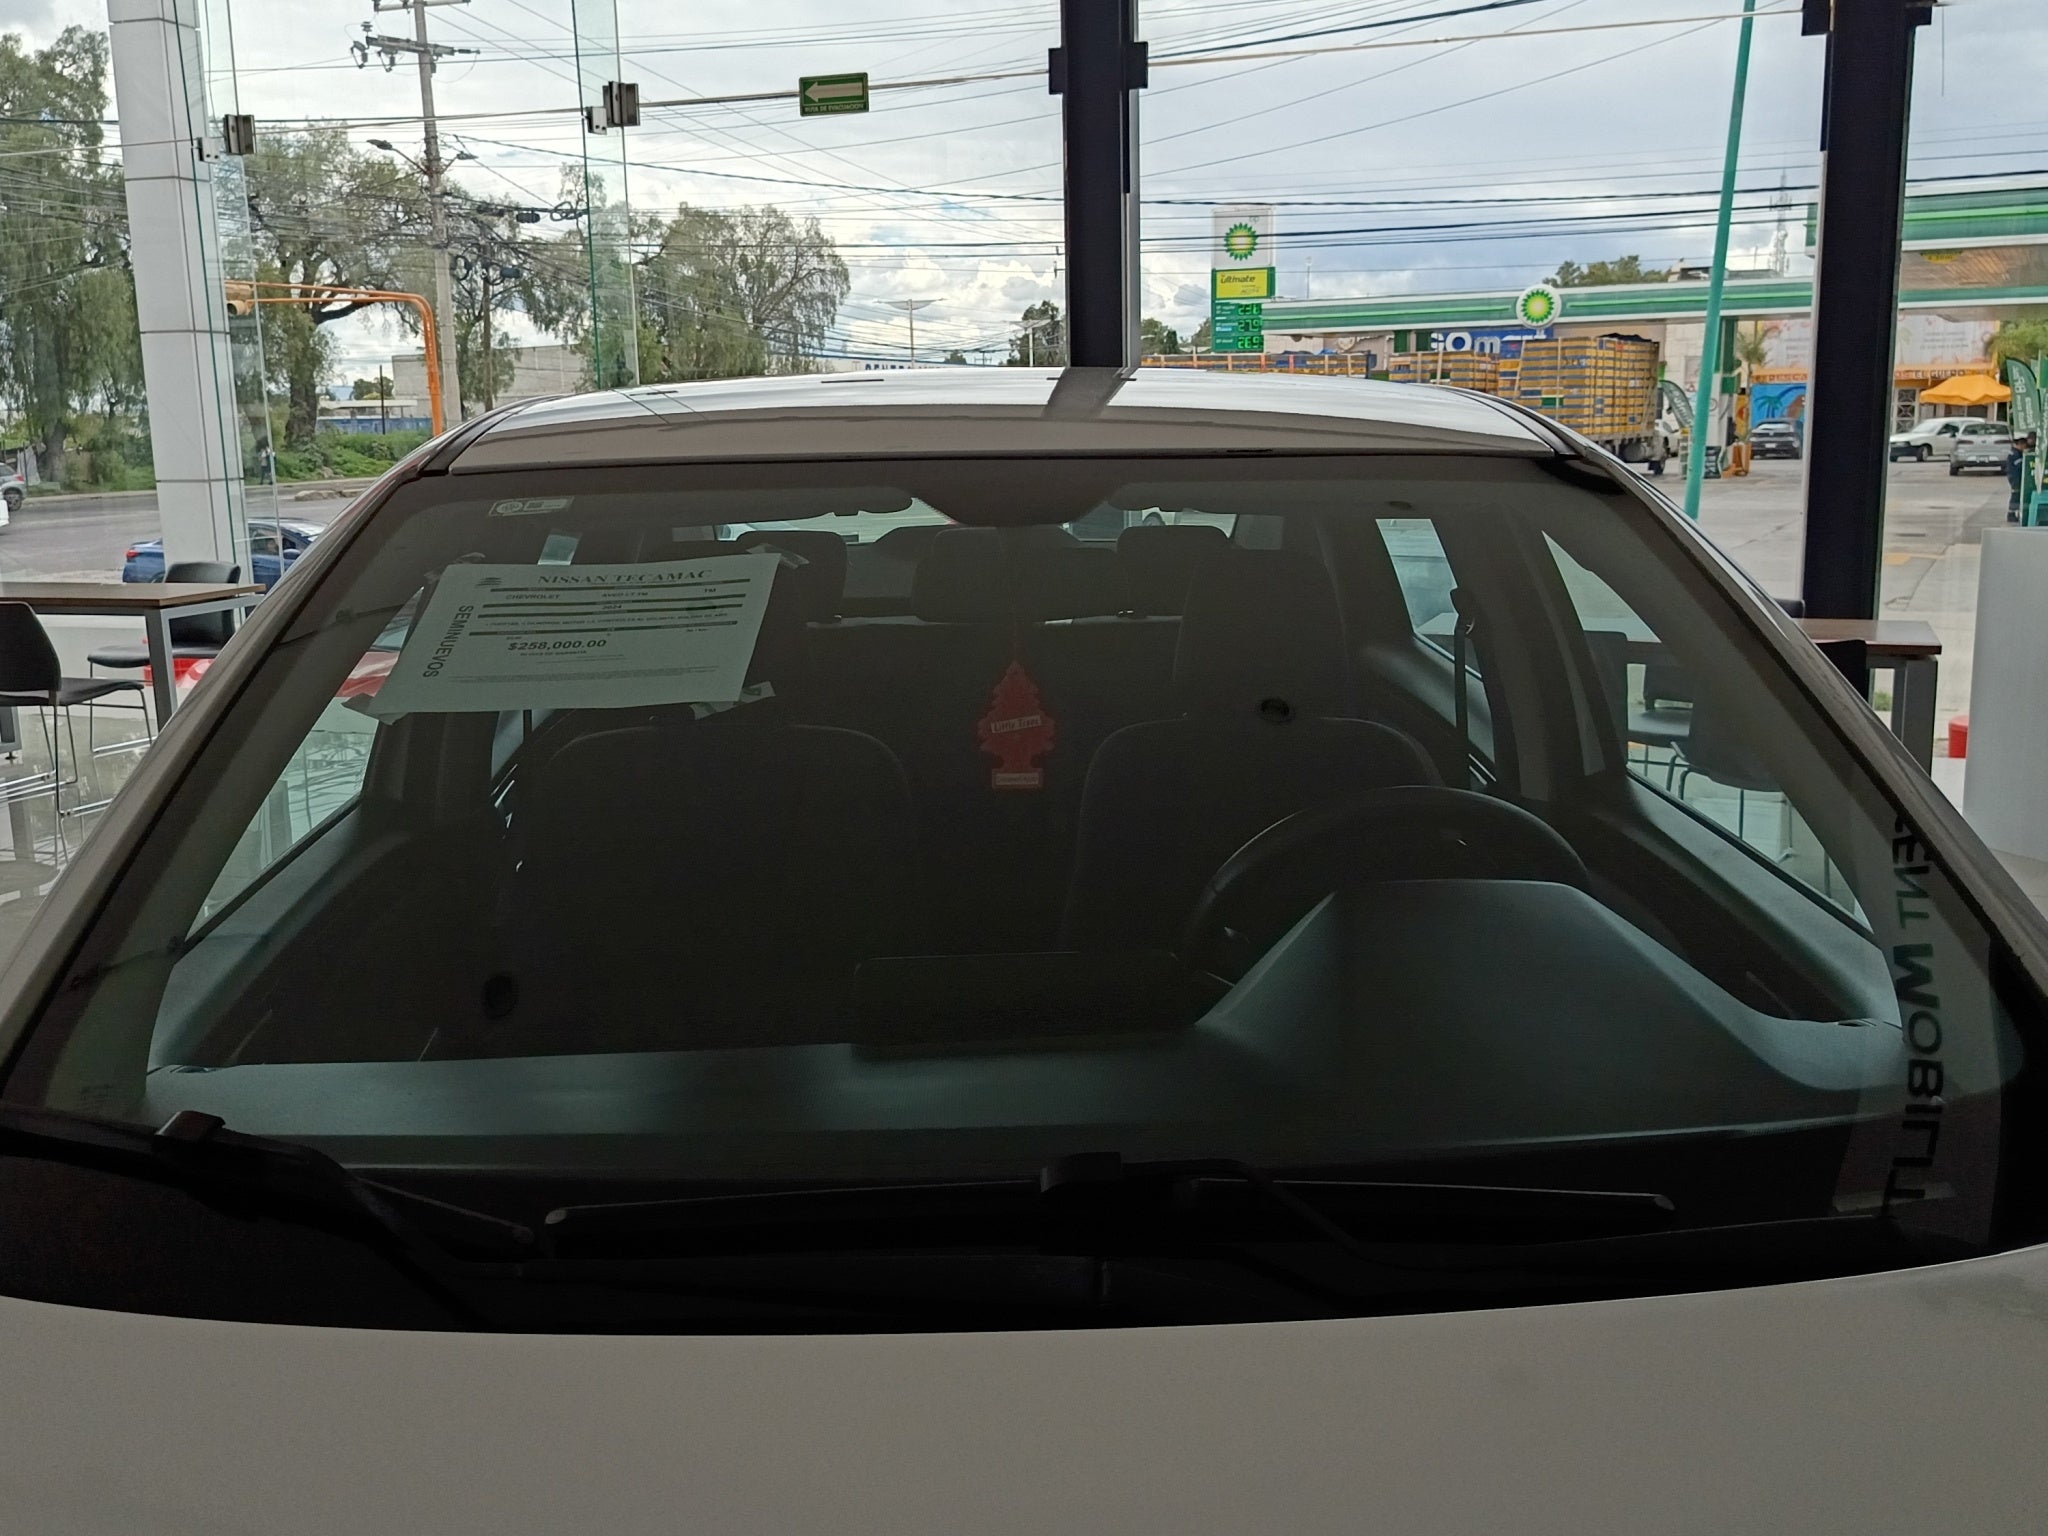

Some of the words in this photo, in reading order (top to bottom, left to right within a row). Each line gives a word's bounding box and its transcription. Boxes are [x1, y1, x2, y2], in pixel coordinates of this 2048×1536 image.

[537, 573, 608, 585] NISSAN
[615, 570, 712, 583] TECAMAC
[505, 593, 561, 601] CHEVROLET
[422, 604, 474, 678] SEMINUEVOS
[508, 639, 607, 652] $258,000.00
